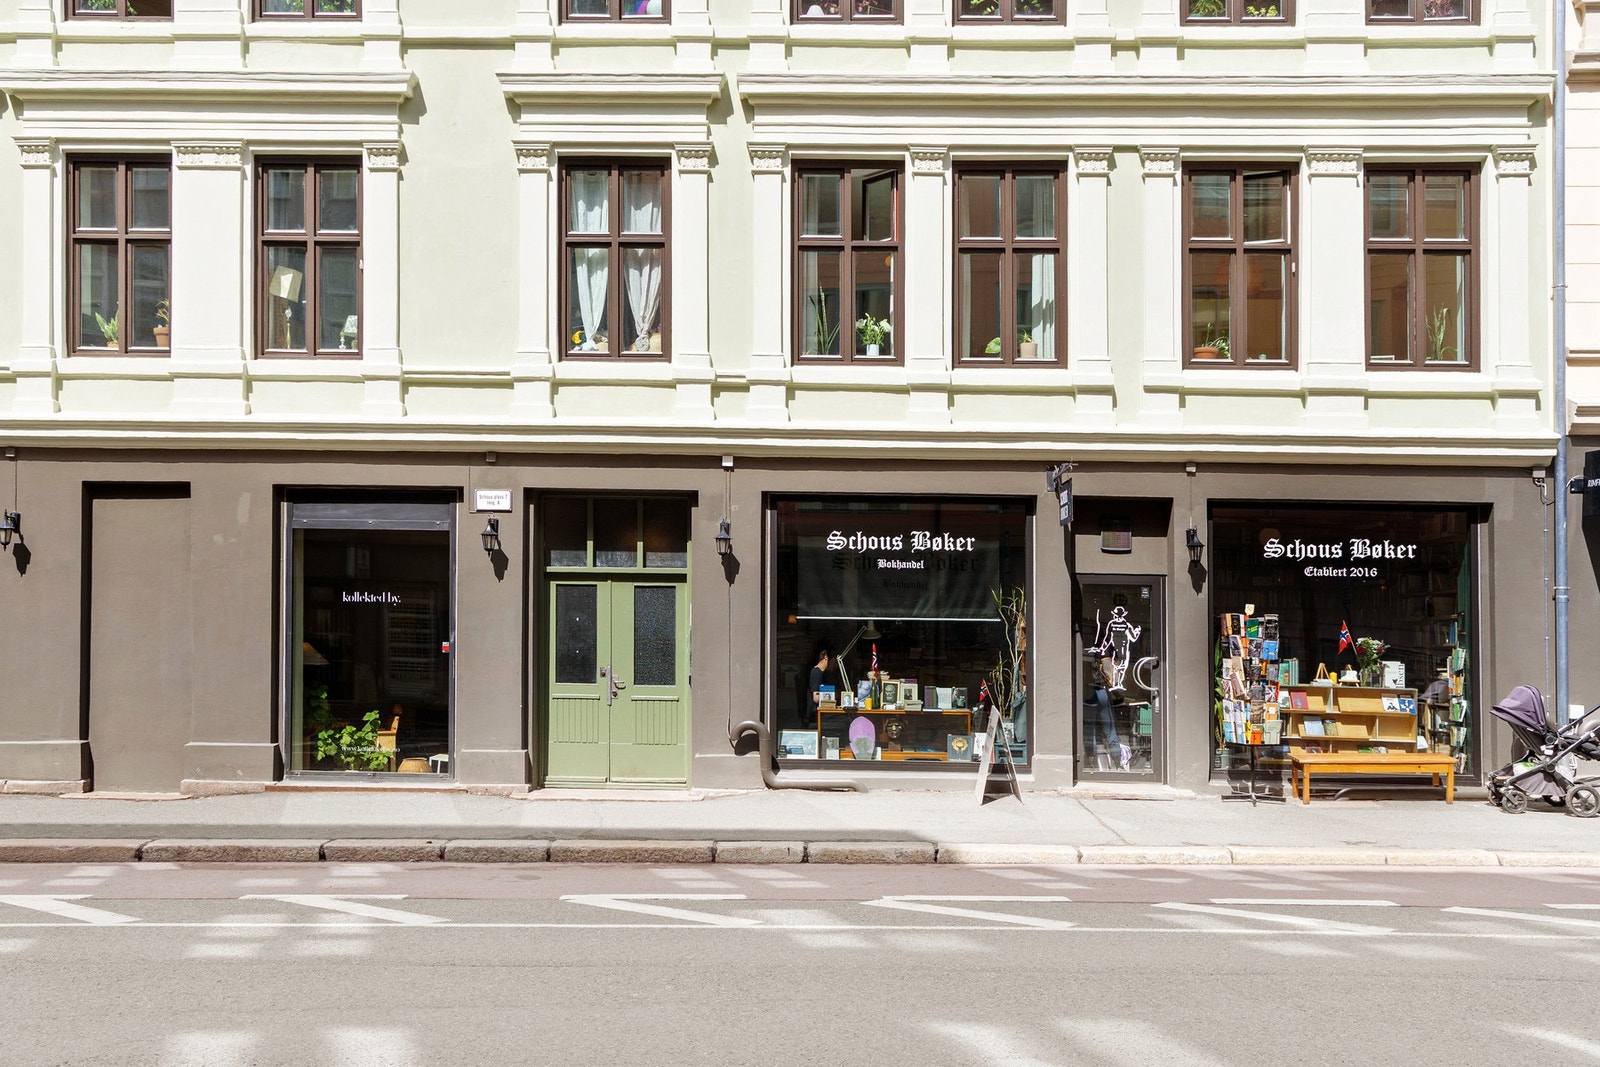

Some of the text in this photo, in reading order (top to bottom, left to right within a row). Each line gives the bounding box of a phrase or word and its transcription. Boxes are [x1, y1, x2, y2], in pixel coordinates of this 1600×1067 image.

[827, 530, 975, 553] Schous Bøker
[1263, 538, 1417, 562] Schous Bøker
[877, 558, 925, 570] Bokhandel
[1304, 566, 1378, 577] Etablert 2016
[342, 591, 386, 603] kollekted
[1395, 664, 1404, 688] Ibsen
